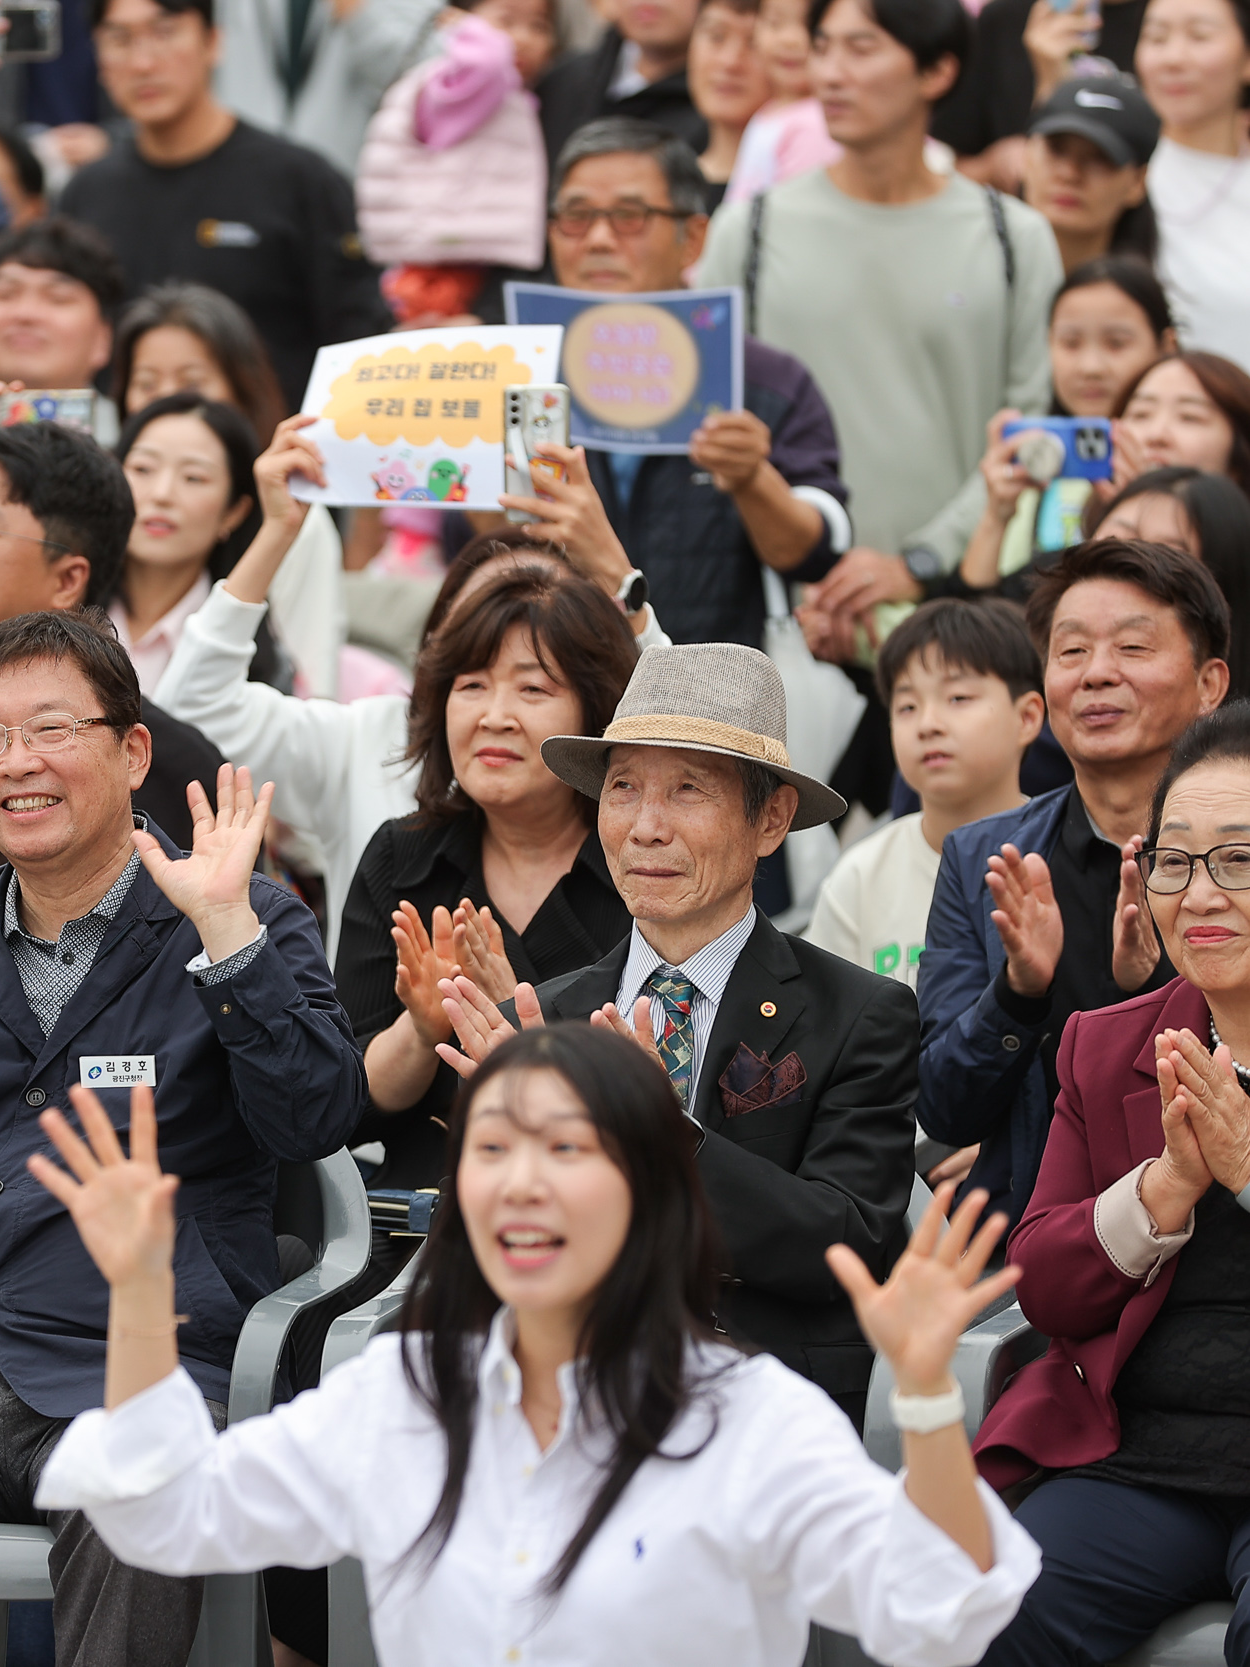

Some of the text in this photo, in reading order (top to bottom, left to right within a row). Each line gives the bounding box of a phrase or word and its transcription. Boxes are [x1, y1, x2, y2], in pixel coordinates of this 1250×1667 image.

[356, 361, 497, 382] 최고다! 잘한다!
[366, 398, 481, 418] 우리 집 보물
[112, 1074, 143, 1082] 광진구청장
